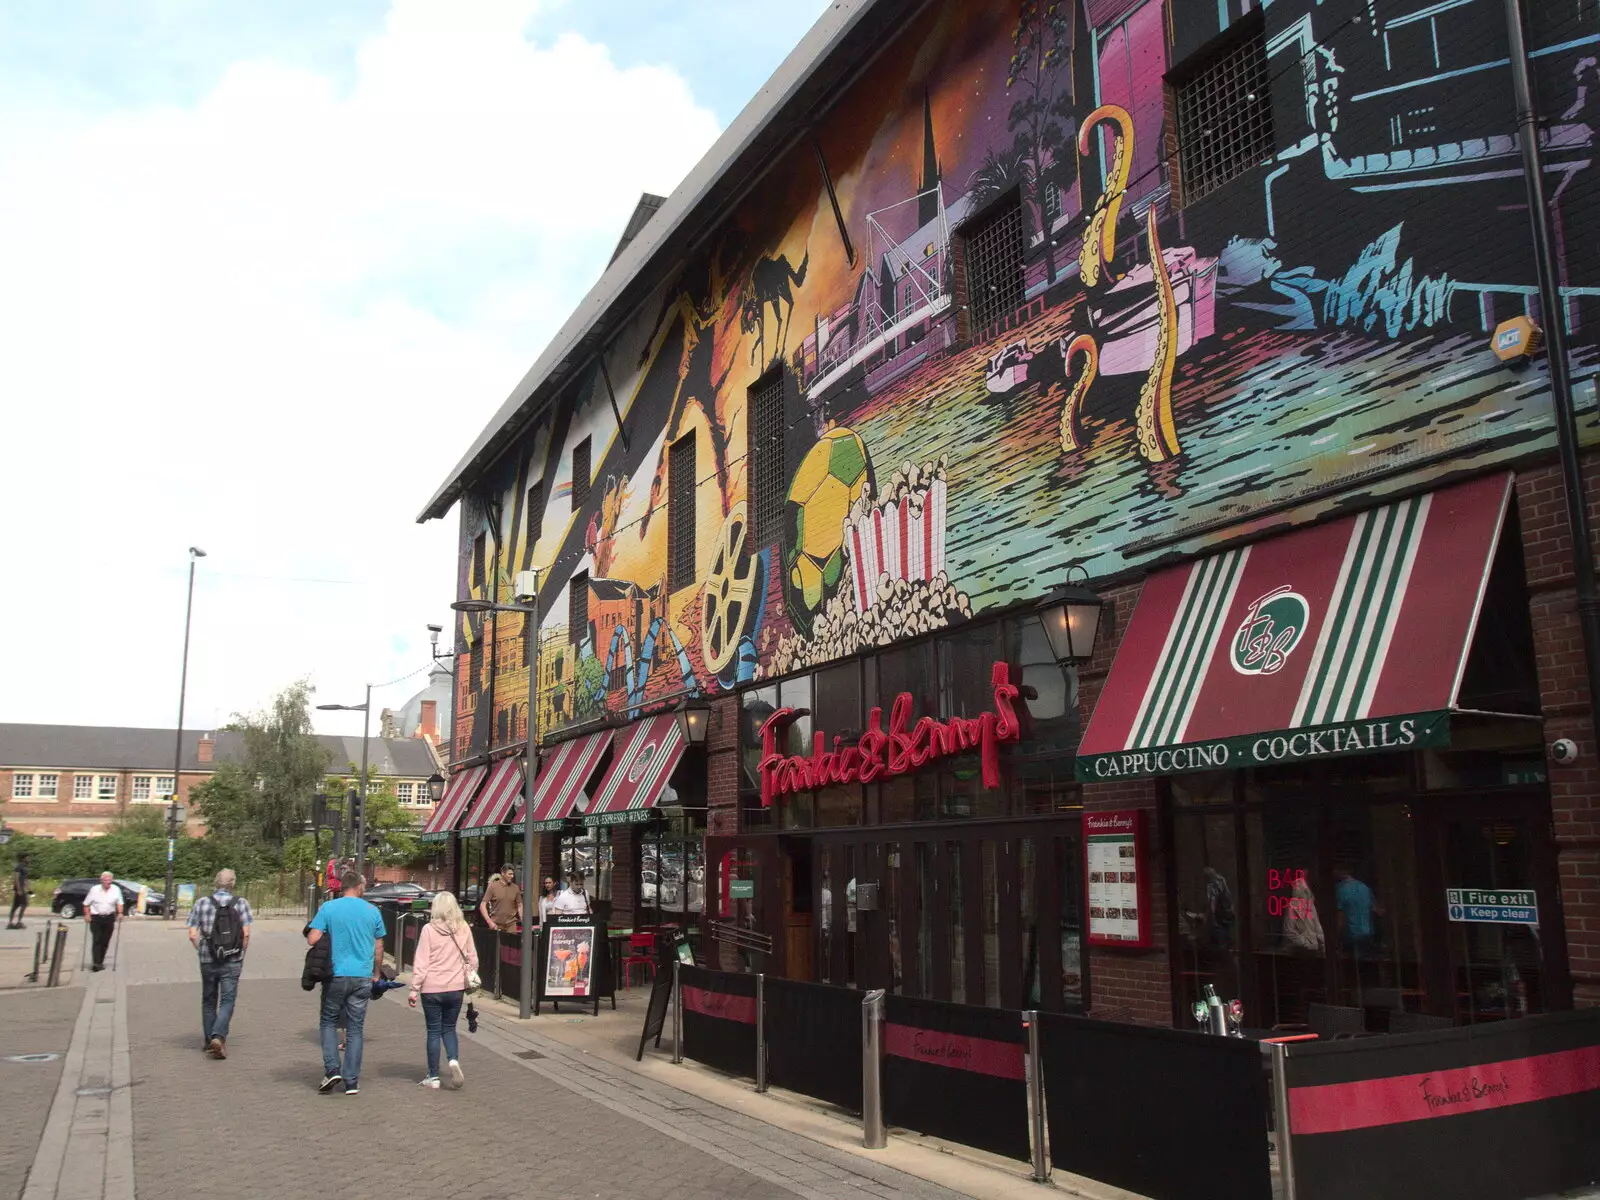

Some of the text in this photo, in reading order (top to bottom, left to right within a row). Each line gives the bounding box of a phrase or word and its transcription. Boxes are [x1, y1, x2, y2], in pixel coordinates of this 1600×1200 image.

[1500, 331, 1520, 347] ADT
[1095, 719, 1416, 777] CAPPUCCINO COCKTAILS
[757, 706, 858, 807] Frankie
[585, 810, 648, 826] PIZZA ESPRESSO WINES
[1088, 816, 1109, 829] Frankie
[1267, 868, 1307, 890] BAR
[1469, 892, 1529, 905] Fire exit
[1267, 895, 1313, 920] OPEN
[1470, 907, 1530, 919] Keep clear
